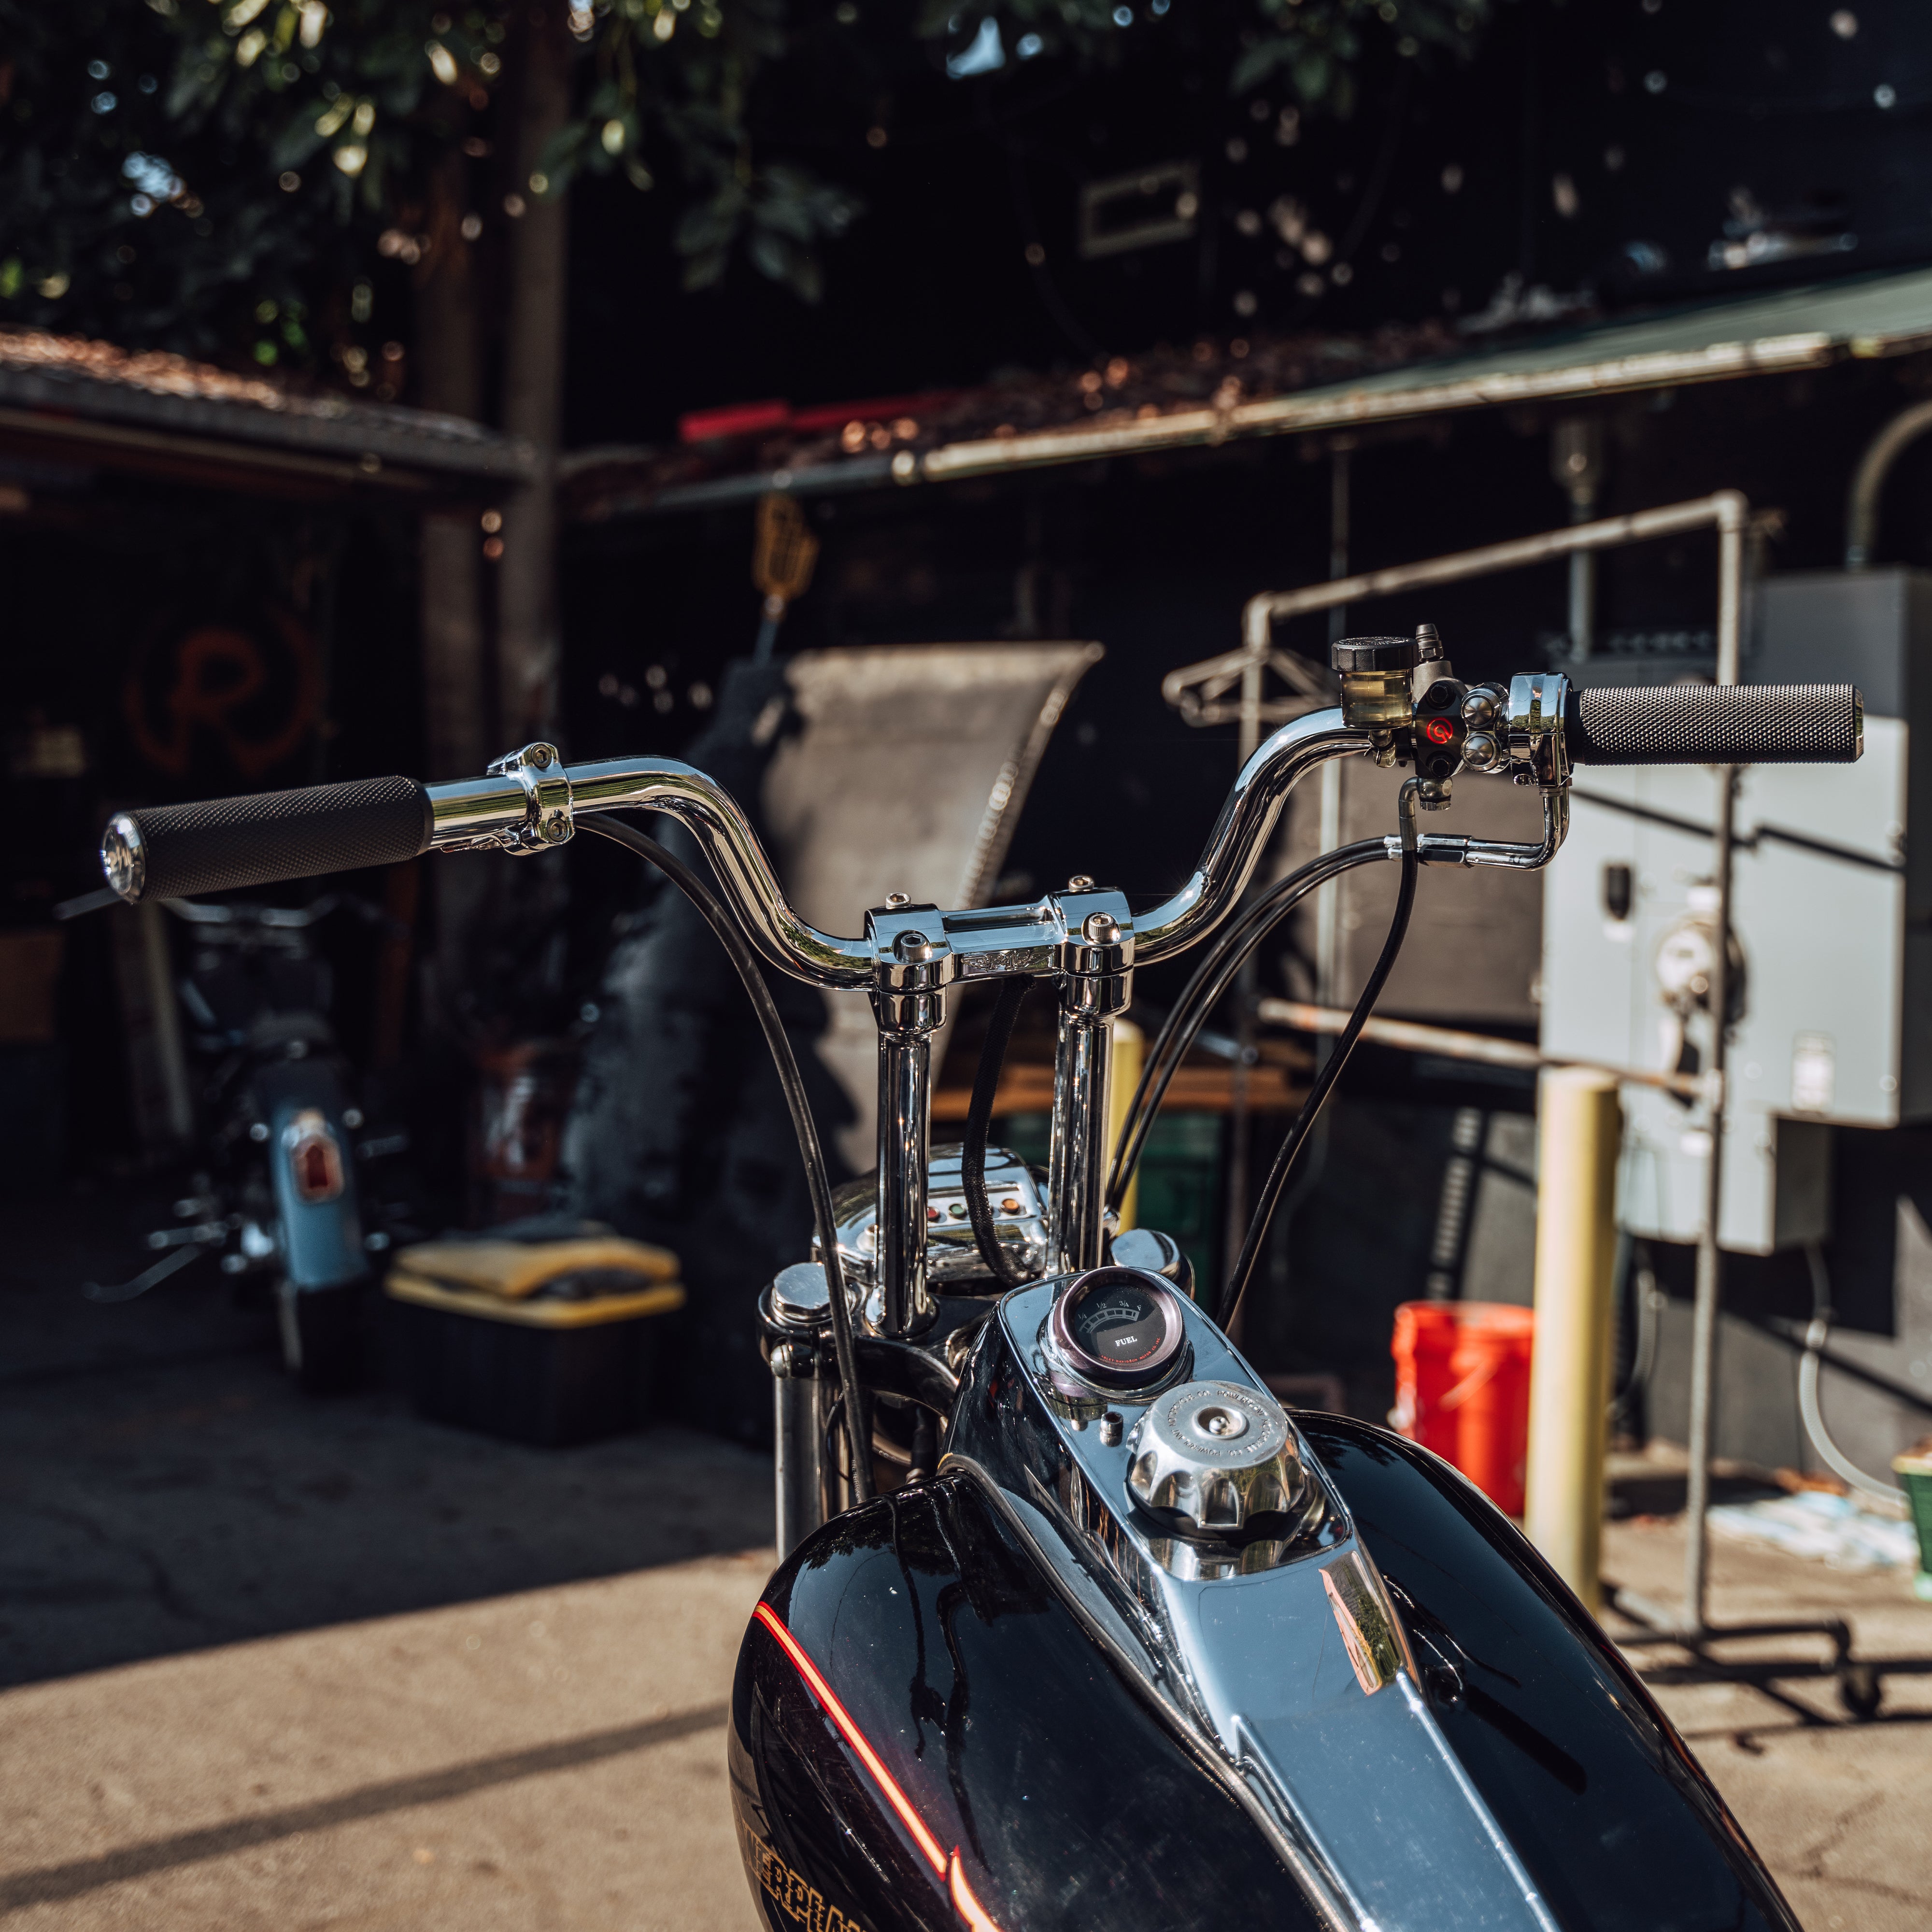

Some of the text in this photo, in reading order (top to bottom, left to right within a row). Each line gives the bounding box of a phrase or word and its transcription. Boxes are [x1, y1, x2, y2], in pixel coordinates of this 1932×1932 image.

[1115, 1336, 1137, 1347] FUEL
[1139, 1351, 1151, 1360] MOTOR
[1171, 1429, 1222, 1457] POWERPLANT
